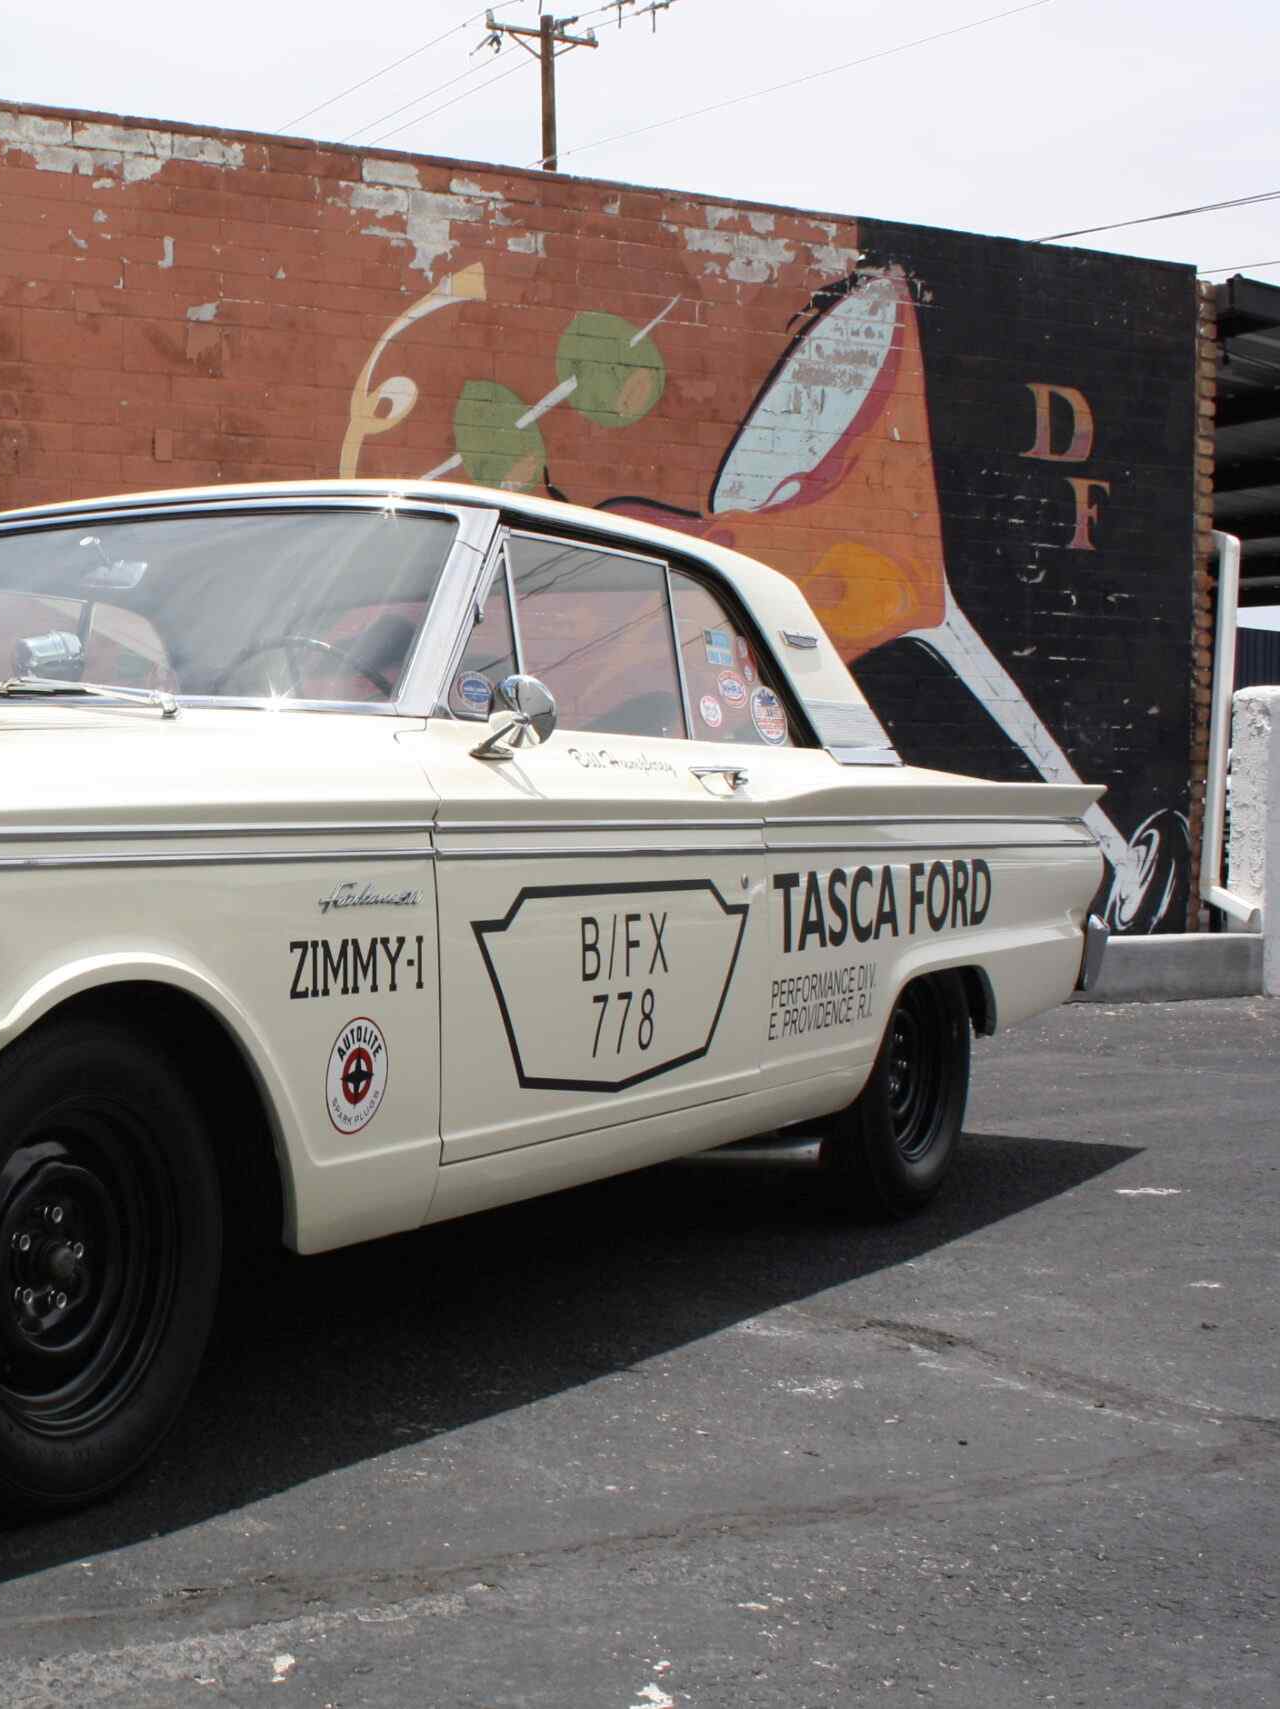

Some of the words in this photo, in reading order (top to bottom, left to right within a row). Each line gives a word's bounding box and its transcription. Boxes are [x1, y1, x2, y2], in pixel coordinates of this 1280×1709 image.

[1020, 382, 1094, 462] D
[1065, 477, 1111, 551] F
[773, 864, 899, 953] TASCA
[909, 859, 991, 935] FORD
[289, 935, 424, 999] ZIMMY-I
[581, 912, 668, 981] B/FX
[771, 966, 856, 1008] PERFORMANCE
[337, 1025, 382, 1061] AUTOLITE
[593, 989, 655, 1058] 778
